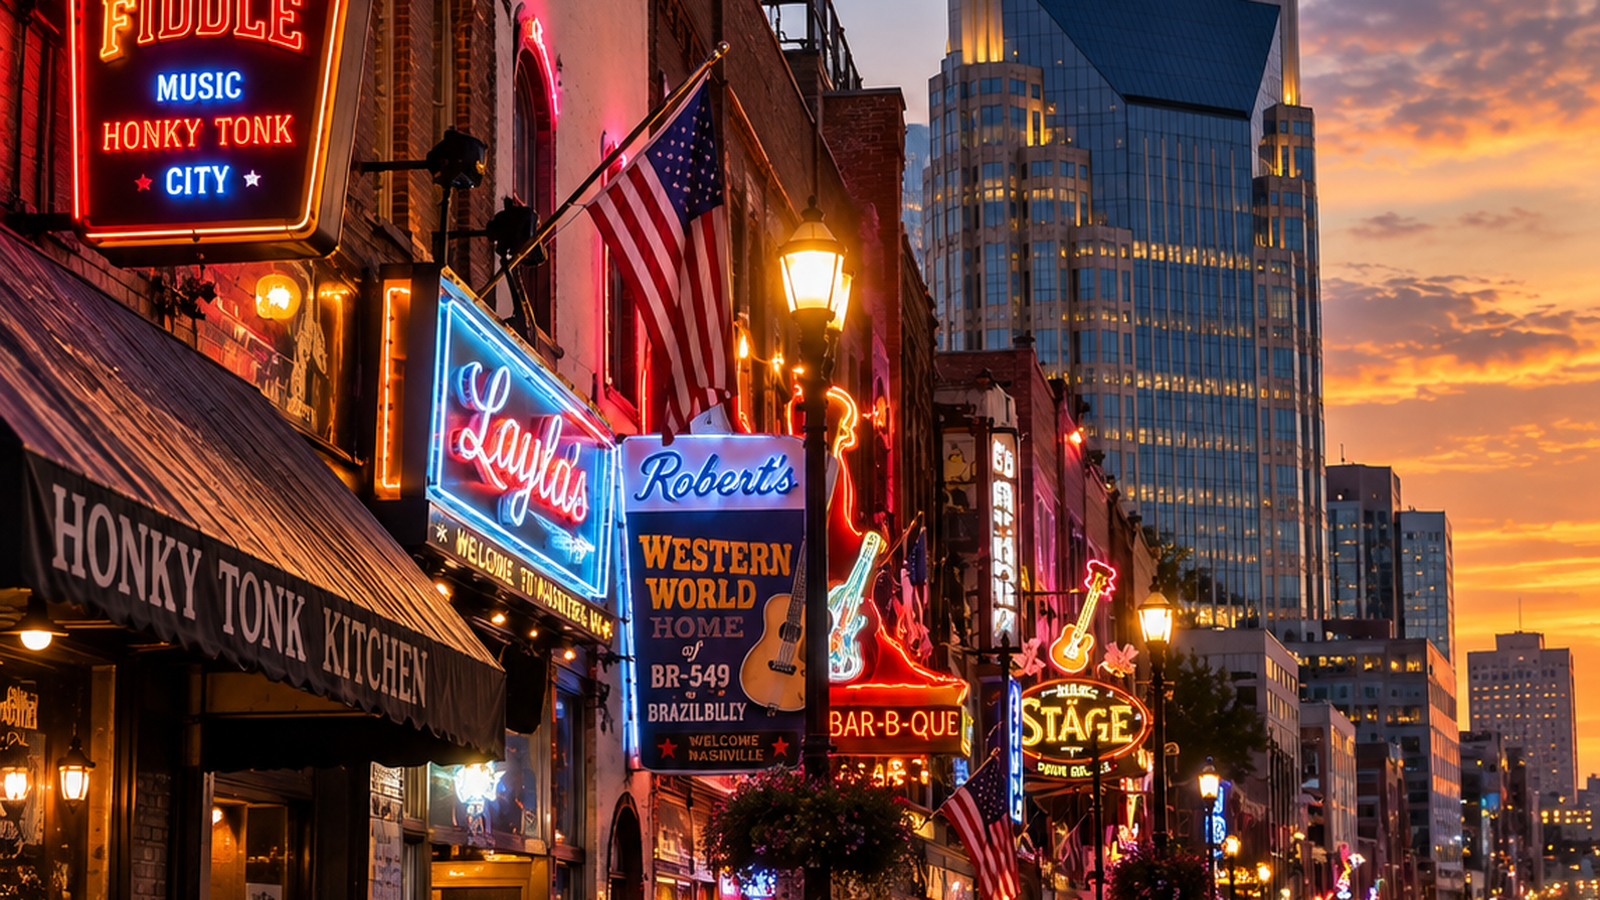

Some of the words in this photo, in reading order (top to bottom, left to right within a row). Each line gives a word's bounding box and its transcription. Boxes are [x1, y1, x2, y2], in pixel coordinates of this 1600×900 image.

[100, 0, 306, 61] FIDDLE
[156, 71, 243, 102] MUSIC
[102, 118, 202, 151] HONKY
[215, 114, 294, 146] TONK
[165, 165, 230, 196] CITY
[457, 361, 588, 527] Layla's
[634, 450, 799, 503] Robert's
[638, 535, 793, 576] WESTERN
[52, 483, 202, 620] HONKY
[218, 559, 307, 663] TONK
[322, 607, 429, 708] KITCHEN
[645, 577, 757, 610] WORLD
[649, 616, 744, 638] HOME
[681, 640, 704, 662] of
[651, 664, 730, 688] BR-549
[829, 711, 960, 740] BAR-B-QUE
